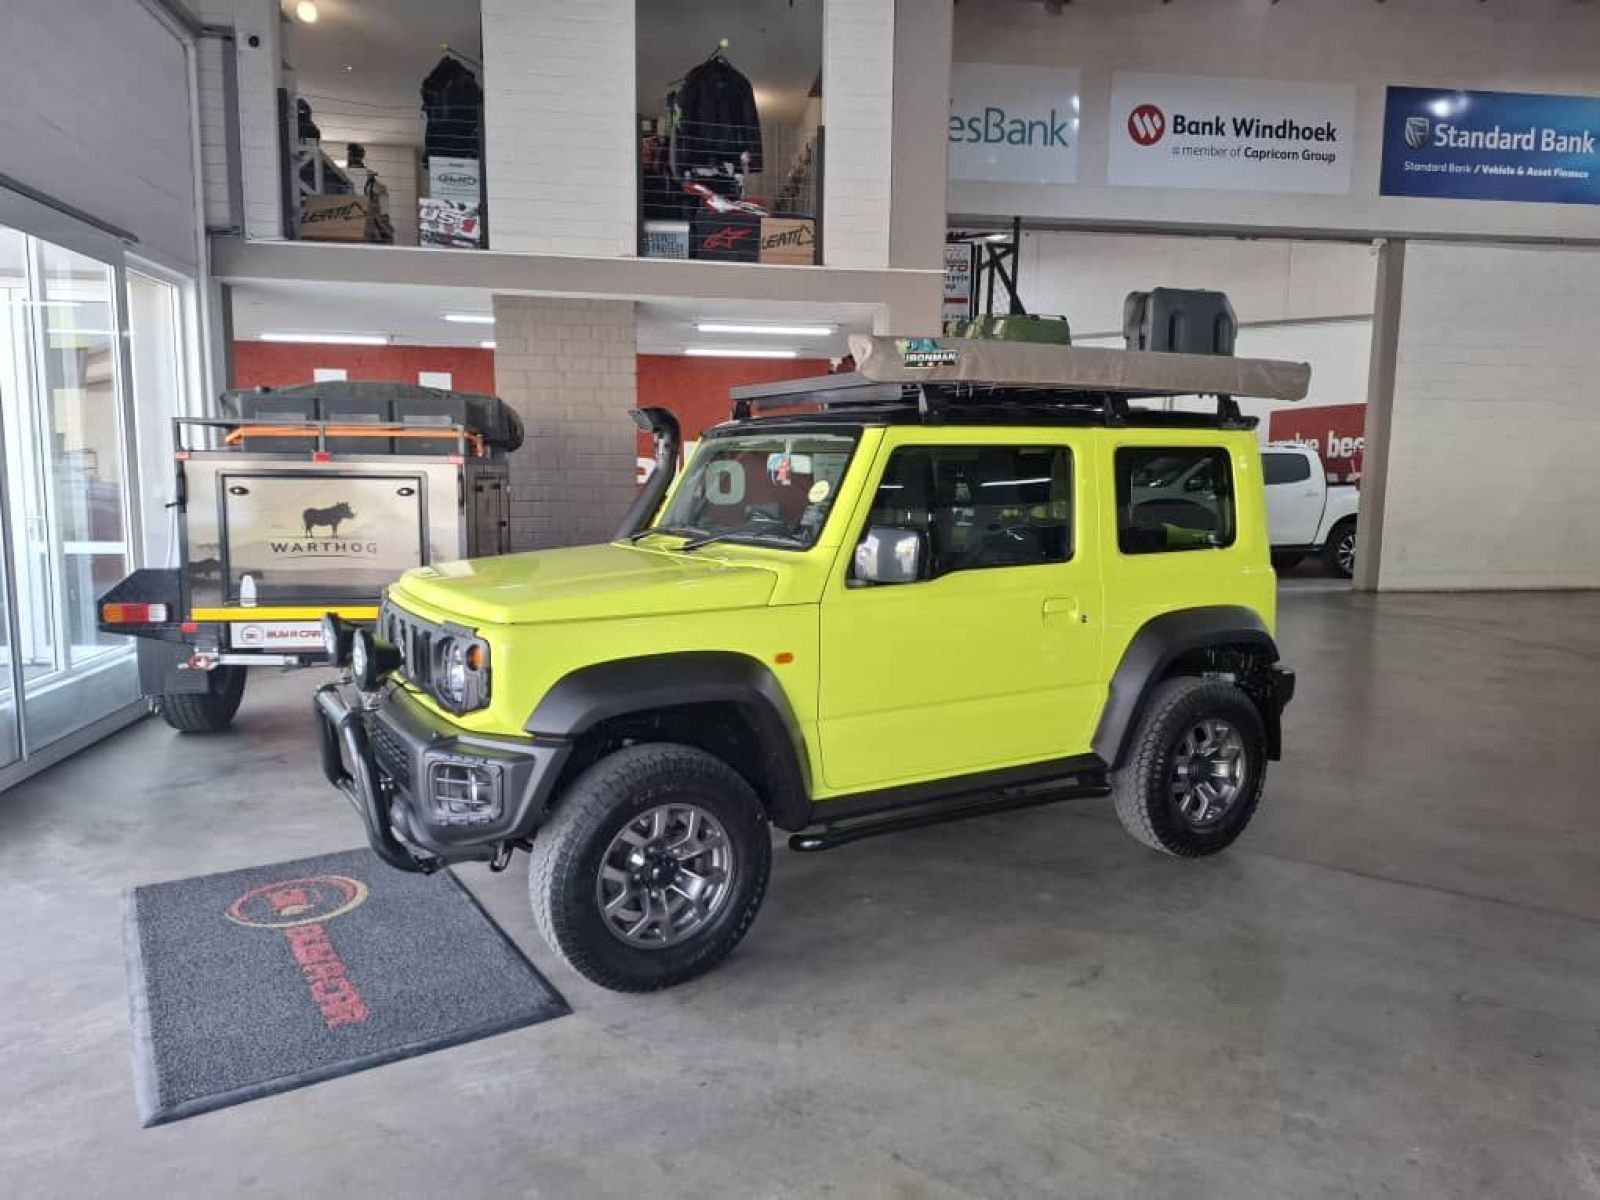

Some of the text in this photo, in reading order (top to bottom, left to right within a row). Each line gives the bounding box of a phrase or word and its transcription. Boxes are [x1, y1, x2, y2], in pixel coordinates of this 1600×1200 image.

[1172, 114, 1337, 142] Bank Windhoek
[1434, 123, 1596, 153] Standard Bank
[1182, 146, 1226, 157] member
[1229, 147, 1241, 158] of
[1243, 147, 1299, 162] Capricorn
[1301, 149, 1336, 164] Group
[1405, 161, 1447, 172] Standard
[1448, 163, 1471, 173] Bank
[1482, 164, 1515, 175] Vehicle
[1527, 167, 1551, 176] Asset
[1553, 168, 1589, 178] Finance
[906, 352, 957, 361] IRONMAN
[270, 542, 377, 553] WARTHOG
